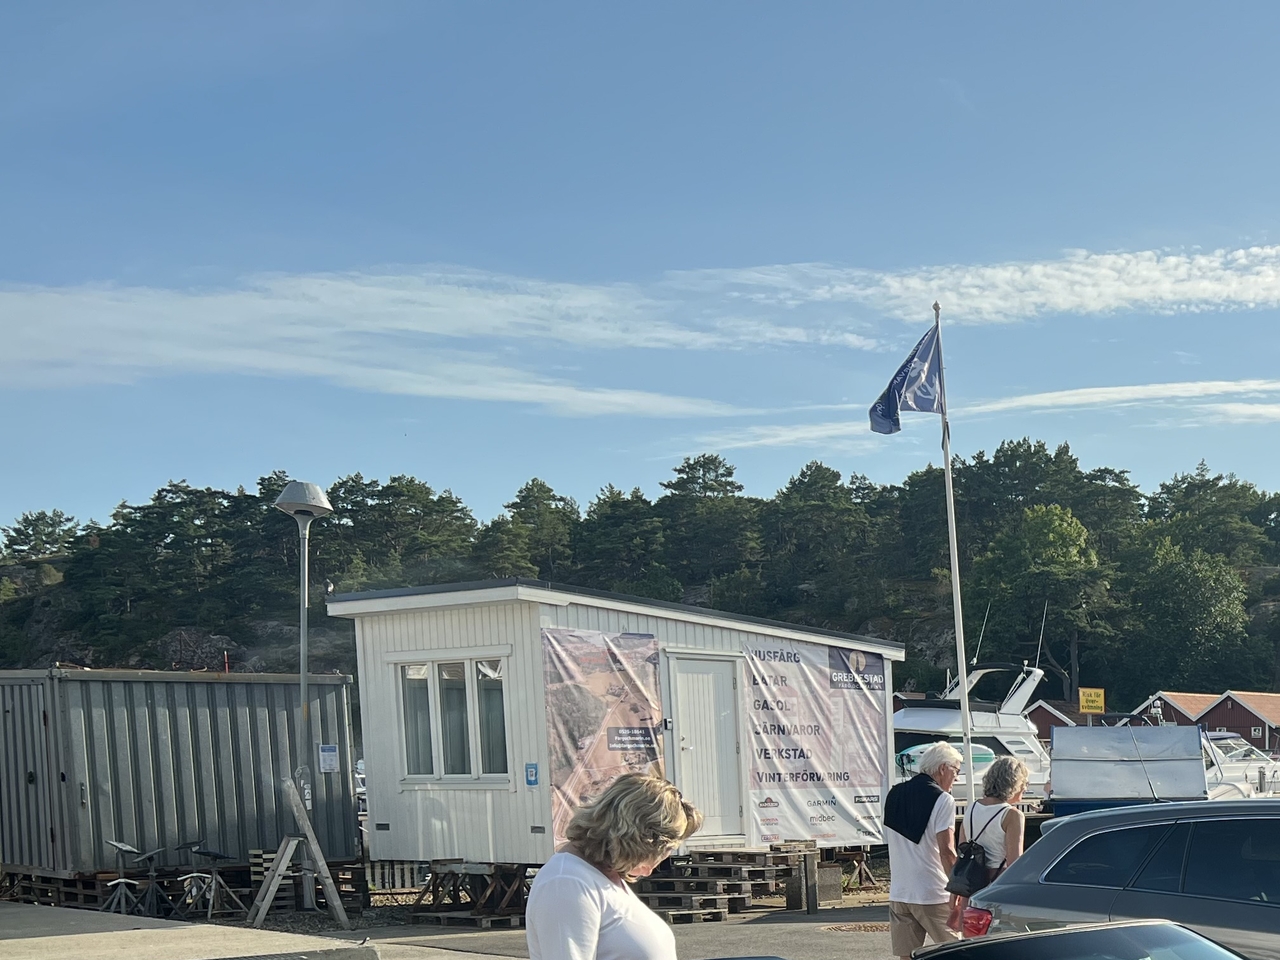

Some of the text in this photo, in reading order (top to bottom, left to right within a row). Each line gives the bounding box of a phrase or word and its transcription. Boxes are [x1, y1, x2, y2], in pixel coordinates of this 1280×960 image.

[751, 648, 801, 663] HUSFÄRG
[753, 699, 791, 712] GASOL
[756, 748, 813, 760] VERKSTAD
[756, 769, 850, 783] VINTERFÖRVARING
